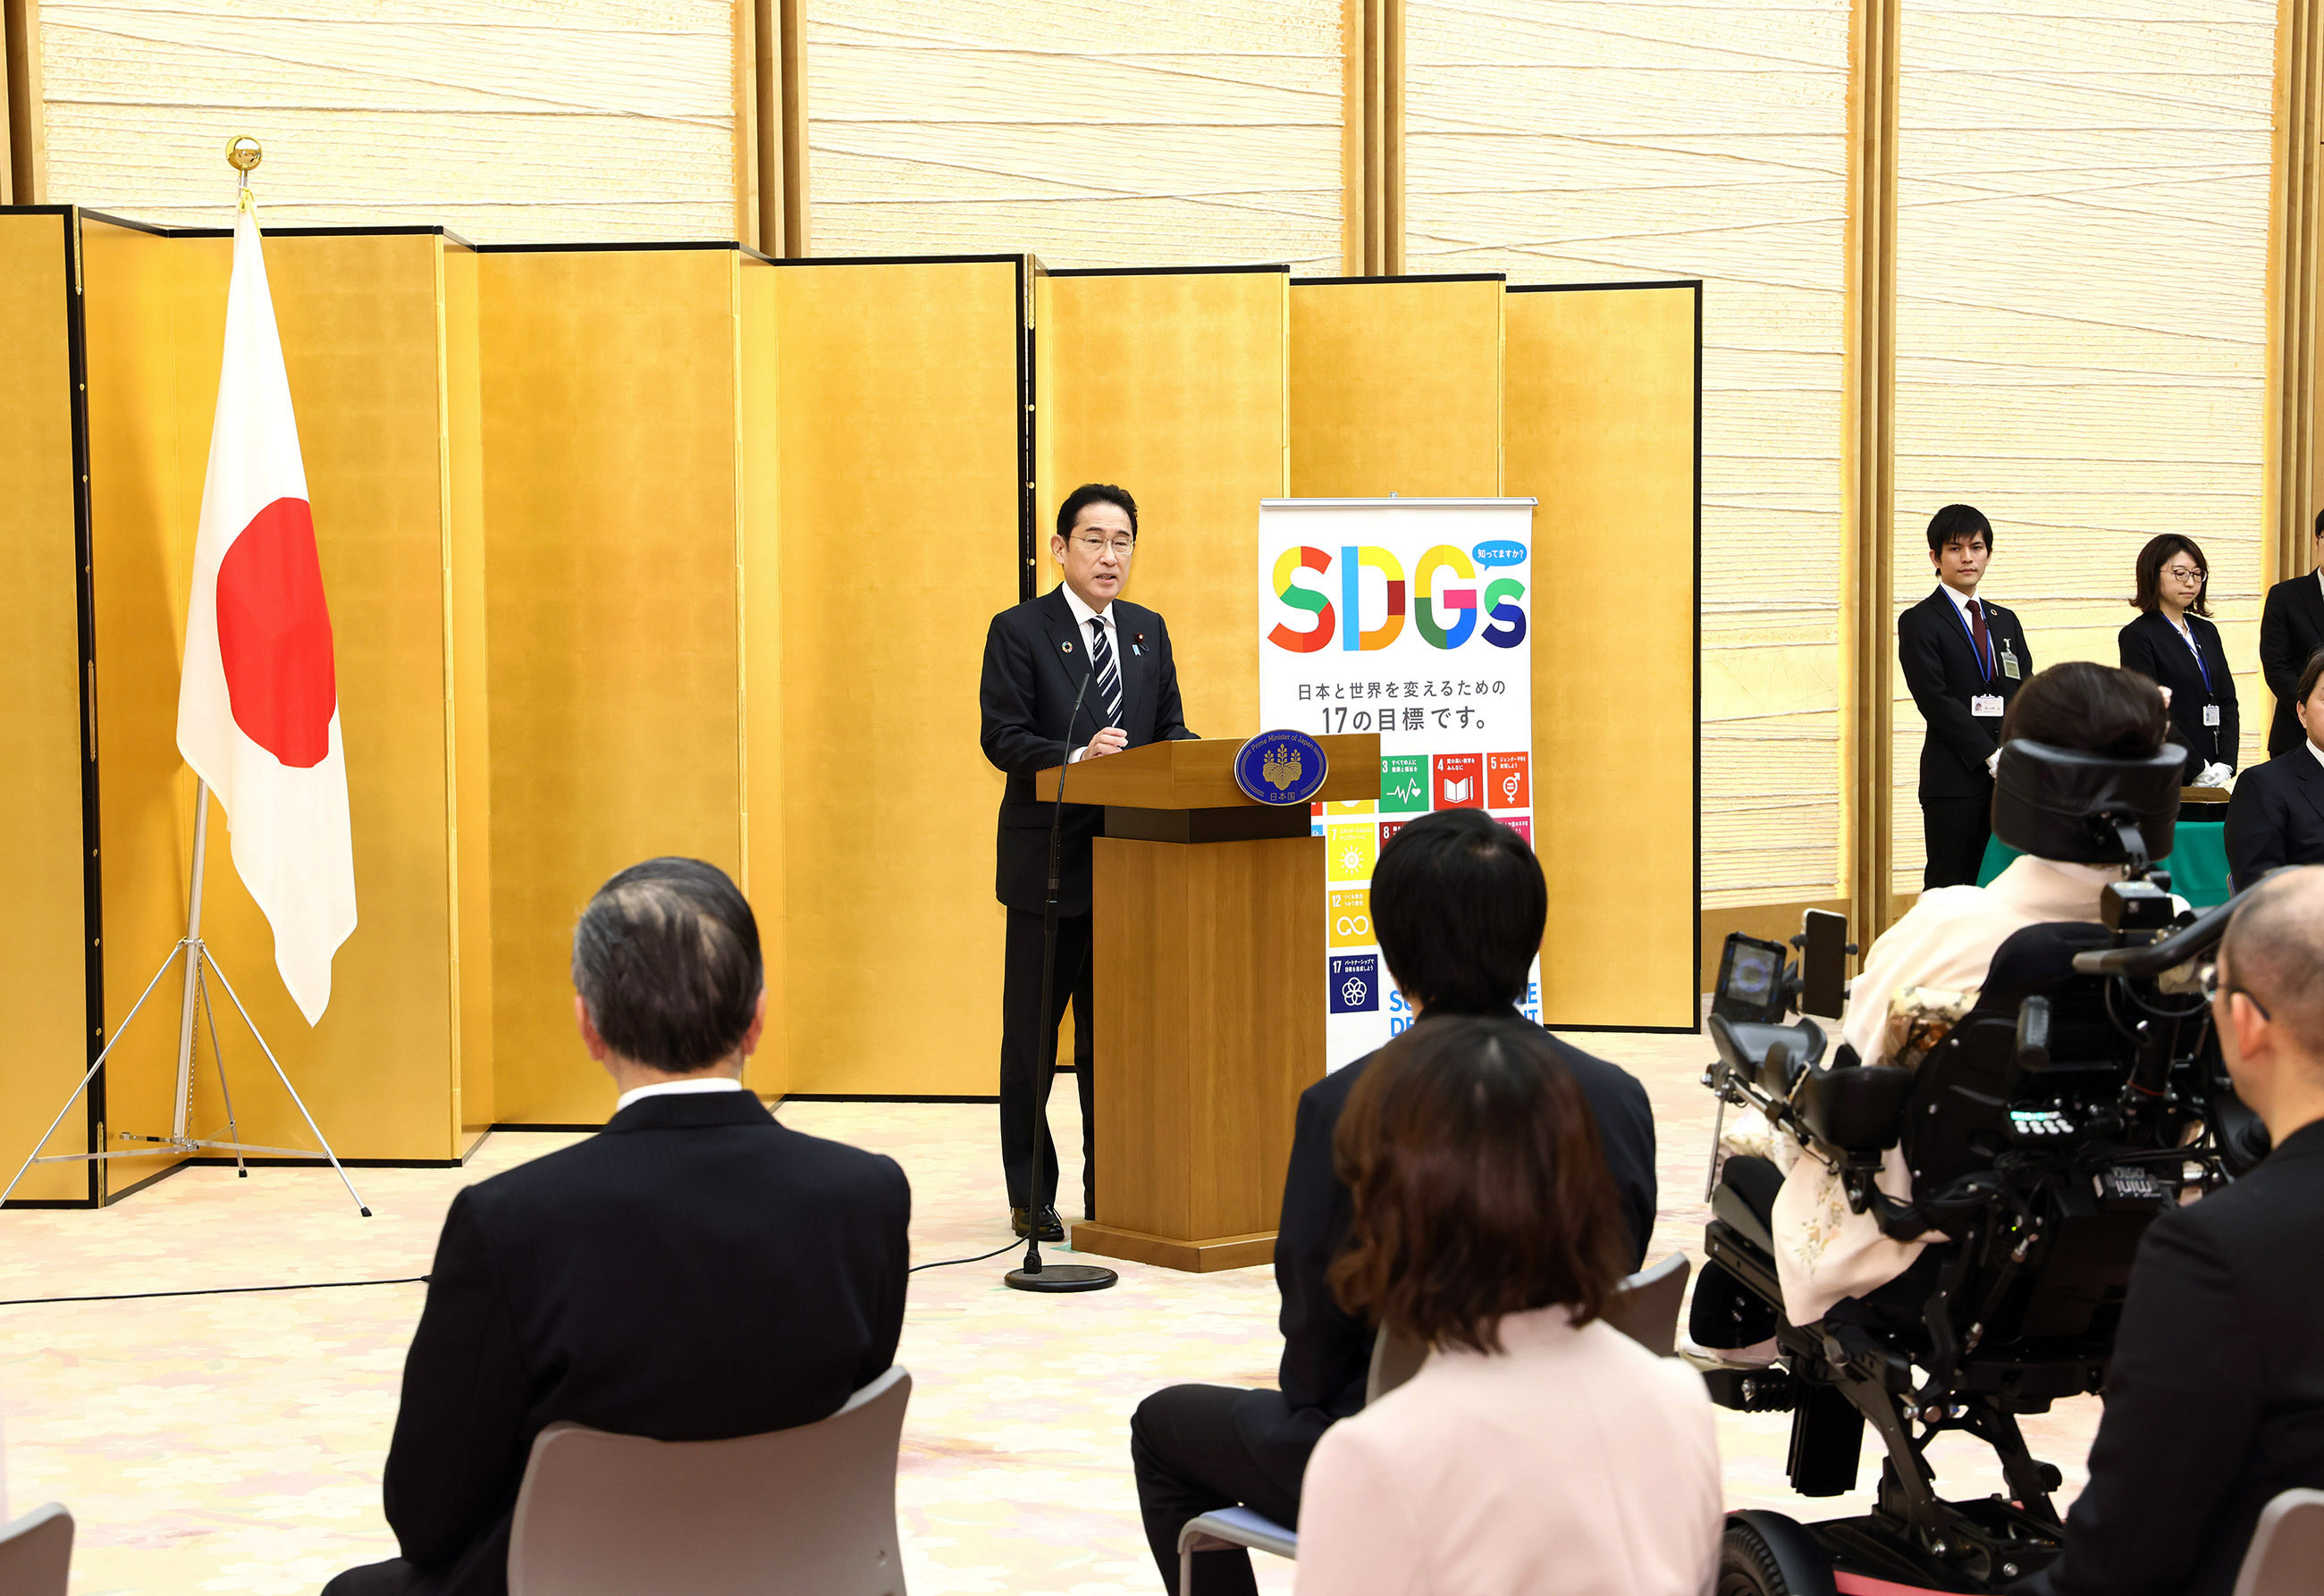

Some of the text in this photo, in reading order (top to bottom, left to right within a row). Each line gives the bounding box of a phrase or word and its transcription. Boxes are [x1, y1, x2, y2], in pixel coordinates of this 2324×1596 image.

[1478, 549, 1524, 559] 知ってますか?
[1267, 543, 1527, 653] SDGs
[1298, 680, 1505, 701] 日本と世界を変えるための
[1323, 706, 1486, 734] 17の目標です。
[1251, 739, 1267, 752] Prime
[1267, 734, 1290, 743] Minister
[1298, 736, 1314, 750] Japan
[1382, 760, 1388, 773] 3
[1437, 758, 1444, 771] 4
[1490, 757, 1497, 769] 5
[1270, 792, 1295, 801] 日本国
[1331, 828, 1337, 842] 7
[1383, 826, 1390, 839] 8
[1332, 895, 1342, 907] 12
[1333, 960, 1342, 973] 17
